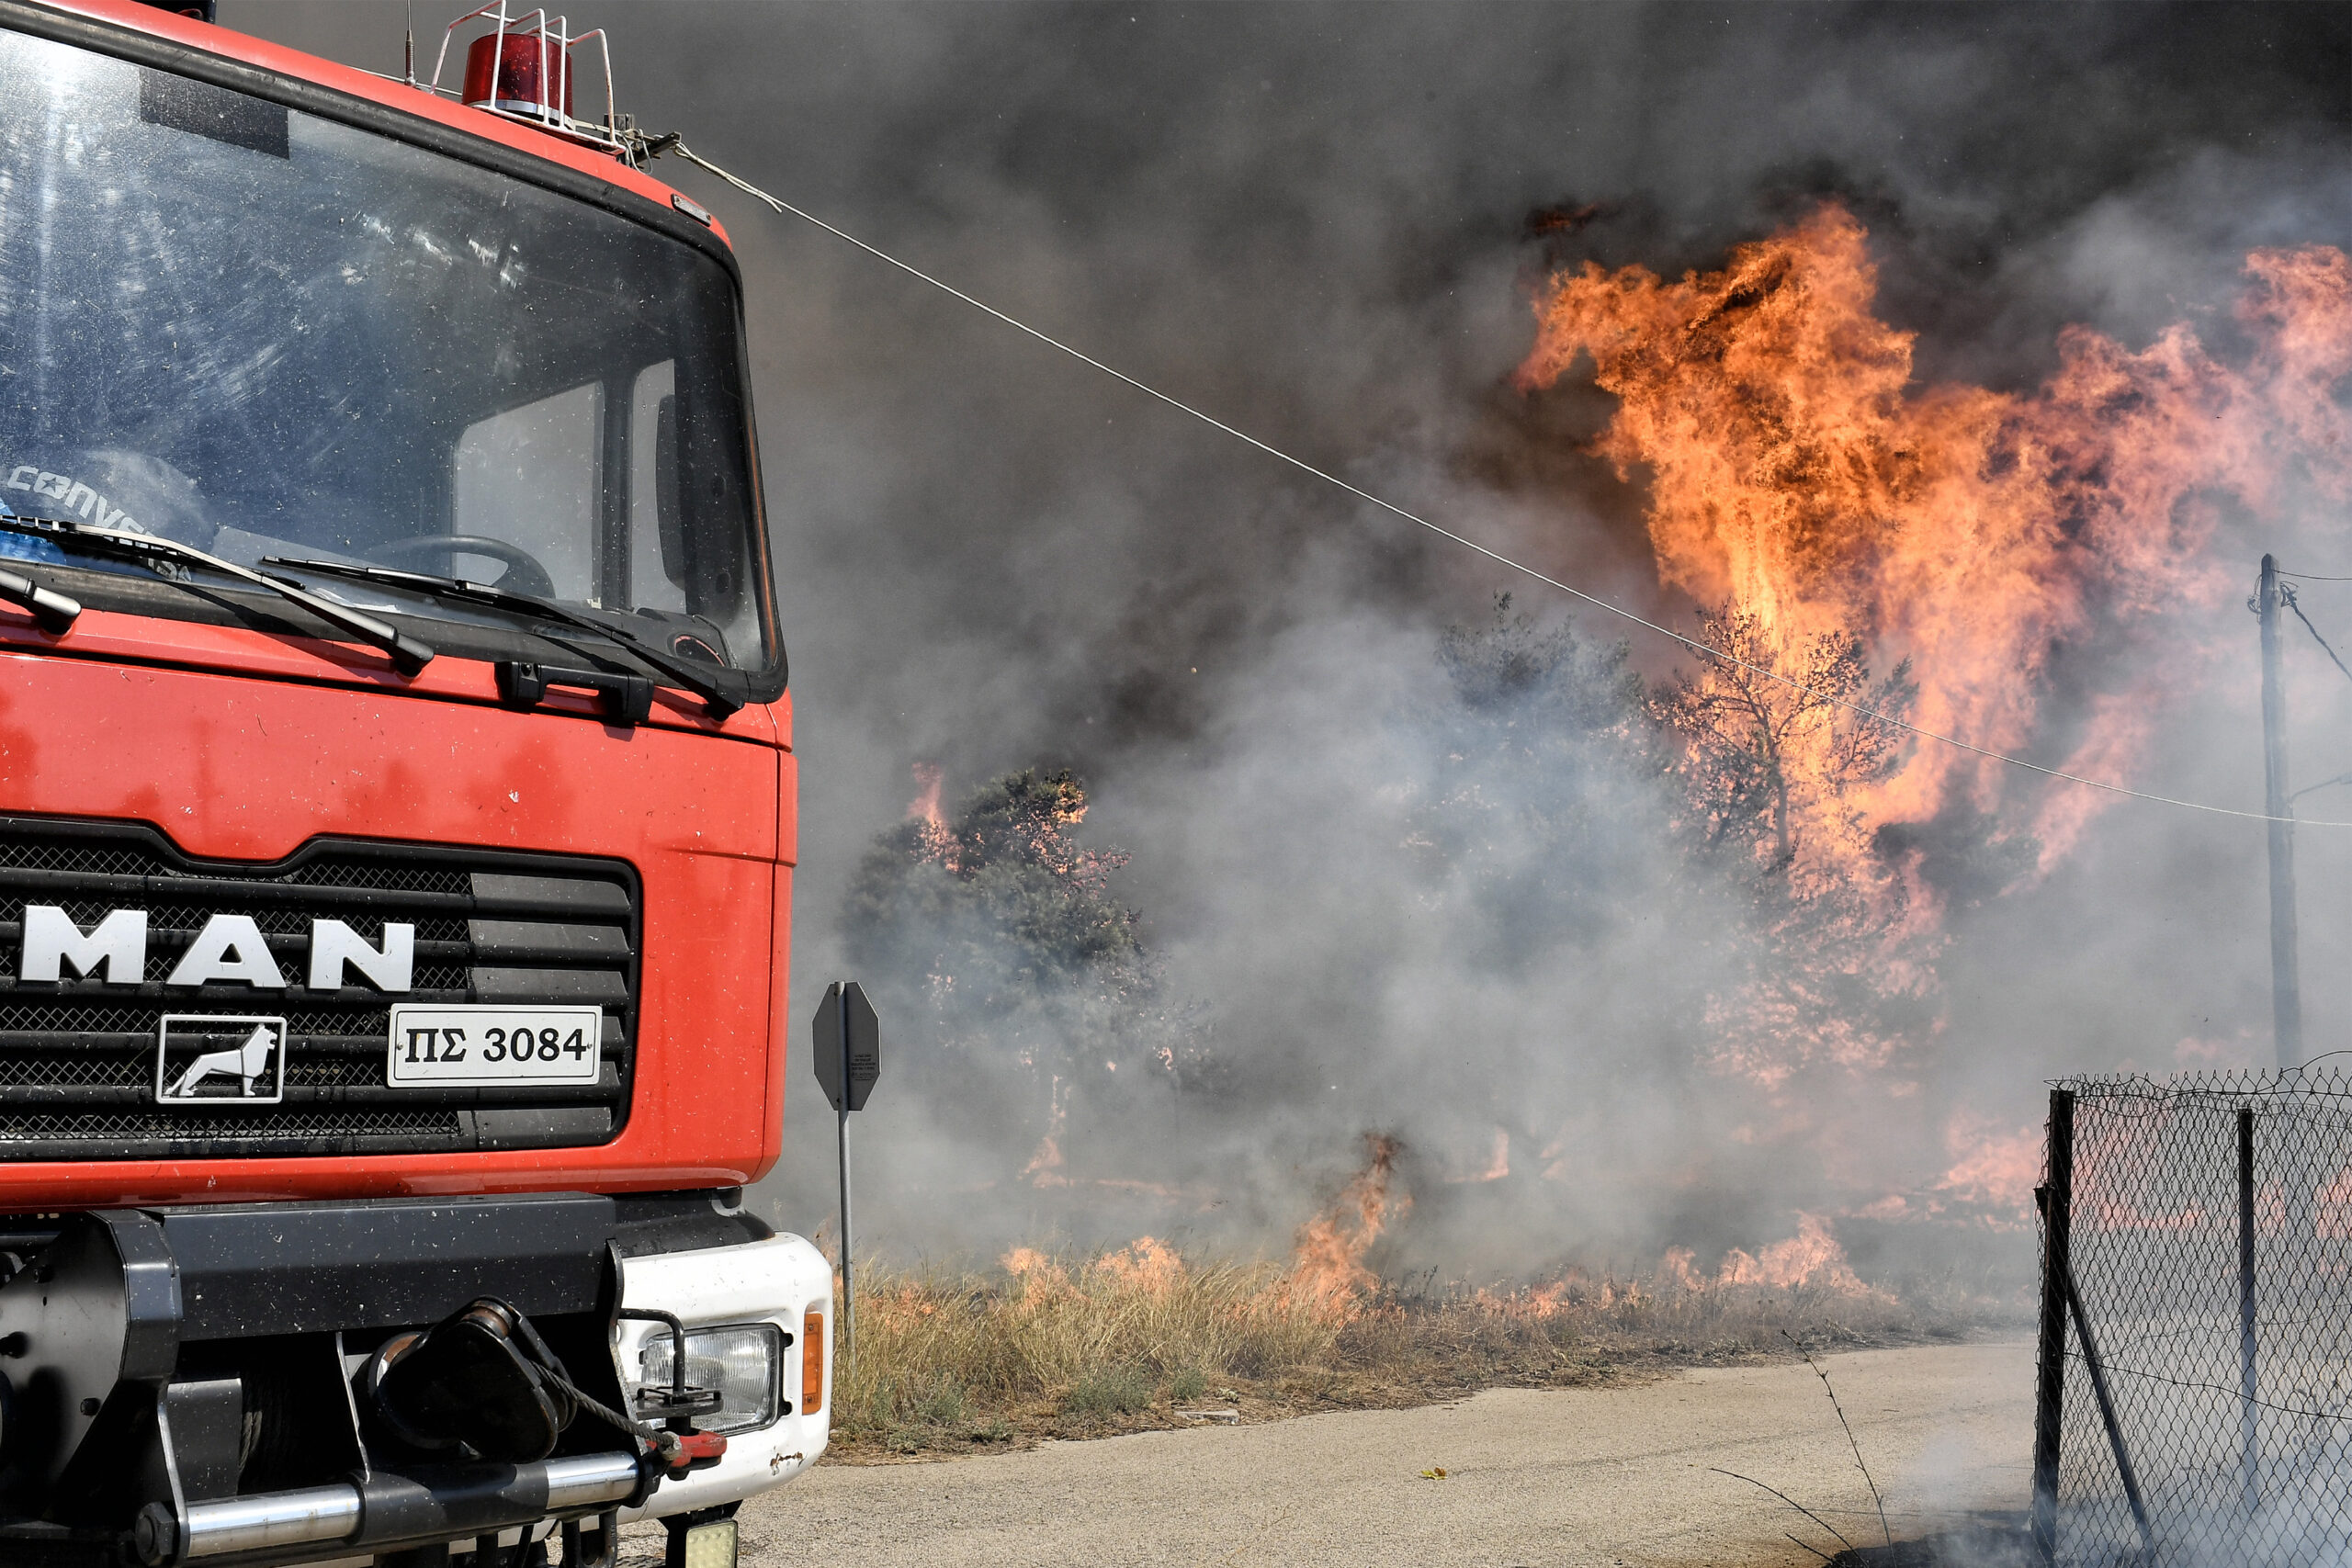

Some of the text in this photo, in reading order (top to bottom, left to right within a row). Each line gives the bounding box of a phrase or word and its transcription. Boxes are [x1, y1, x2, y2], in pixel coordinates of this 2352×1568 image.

[20, 905, 415, 992] MAN
[405, 1027, 587, 1063] ΠΣ 3084
